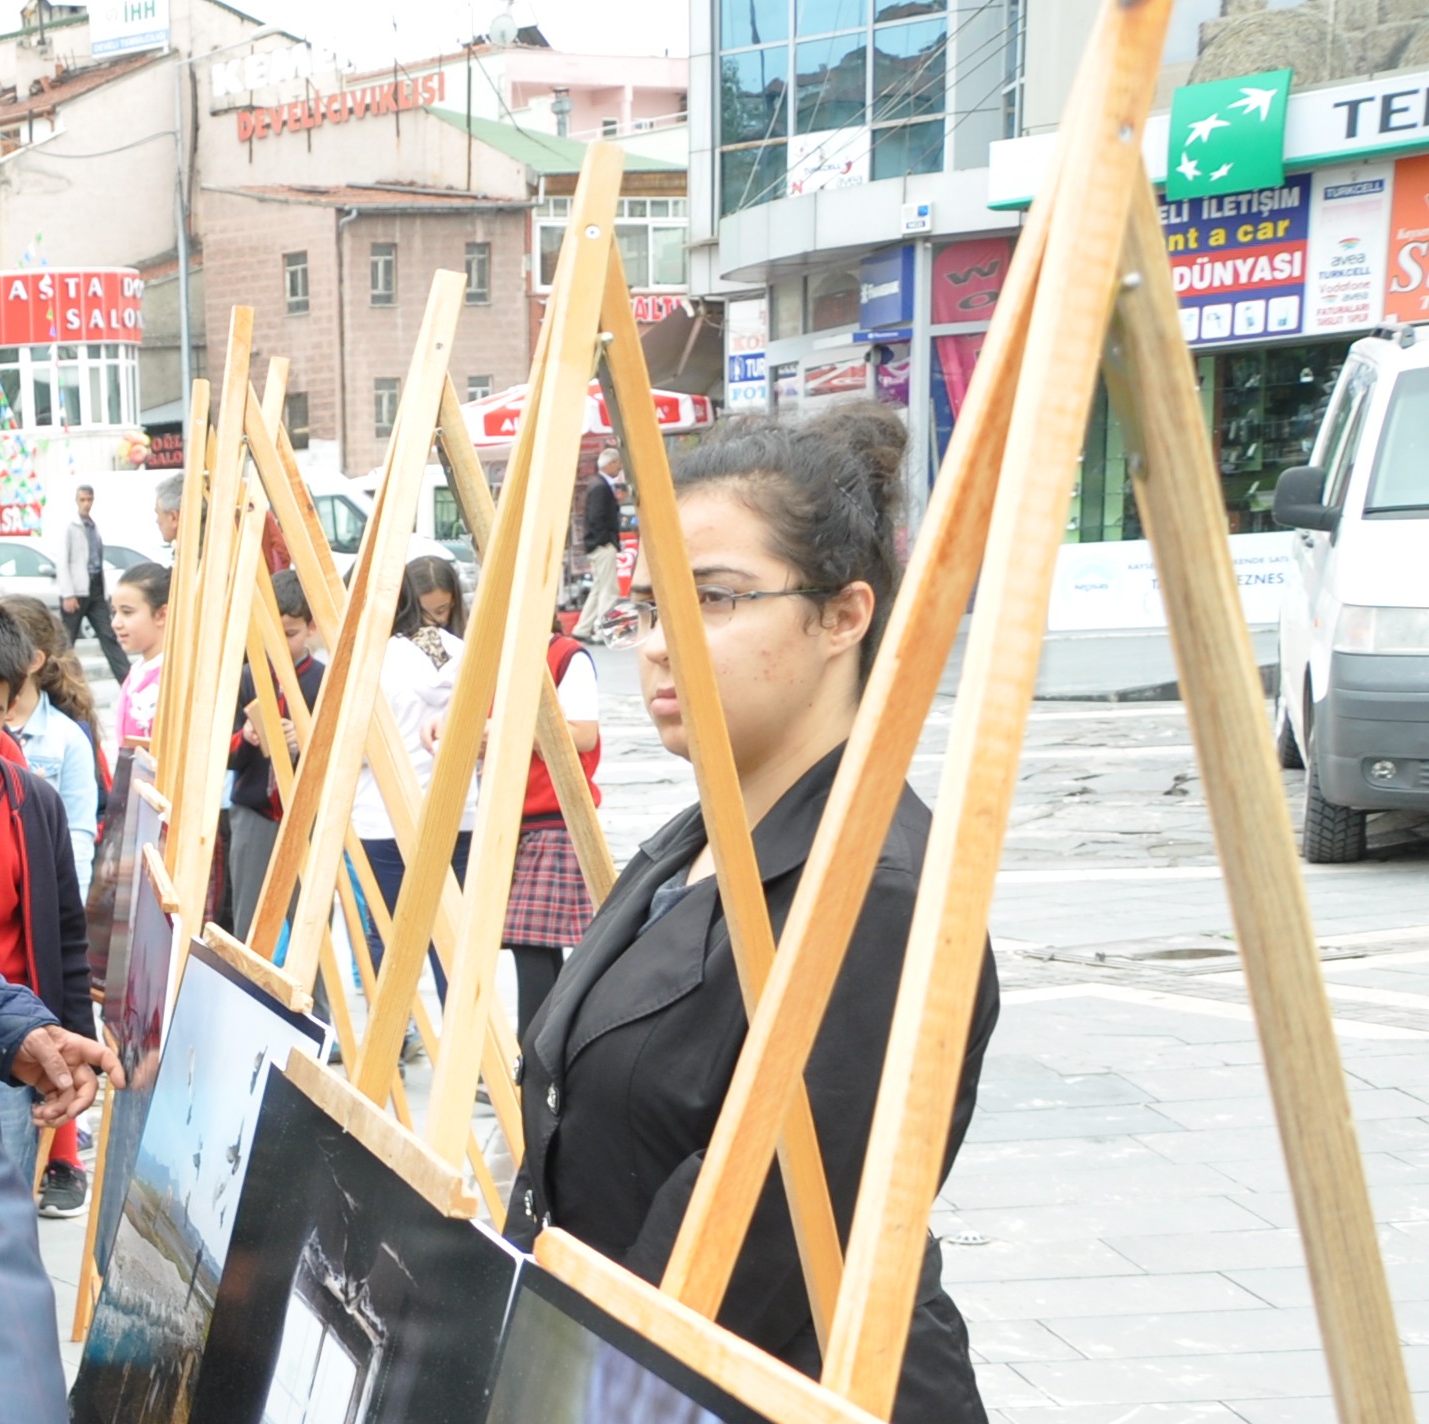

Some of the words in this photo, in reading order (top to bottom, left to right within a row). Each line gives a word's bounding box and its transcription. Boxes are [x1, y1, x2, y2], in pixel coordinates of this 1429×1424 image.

[238, 90, 322, 142] DEVELİ
[1332, 86, 1429, 140] TE
[1202, 185, 1301, 219] İLETİŞİM
[1325, 181, 1384, 198] TURKCELL
[1209, 227, 1227, 246] a
[1237, 218, 1290, 243] car
[1173, 250, 1303, 292] DÜNYASI
[1318, 267, 1372, 280] TURKCELL
[1331, 253, 1366, 267] avea
[1342, 291, 1370, 302] avea
